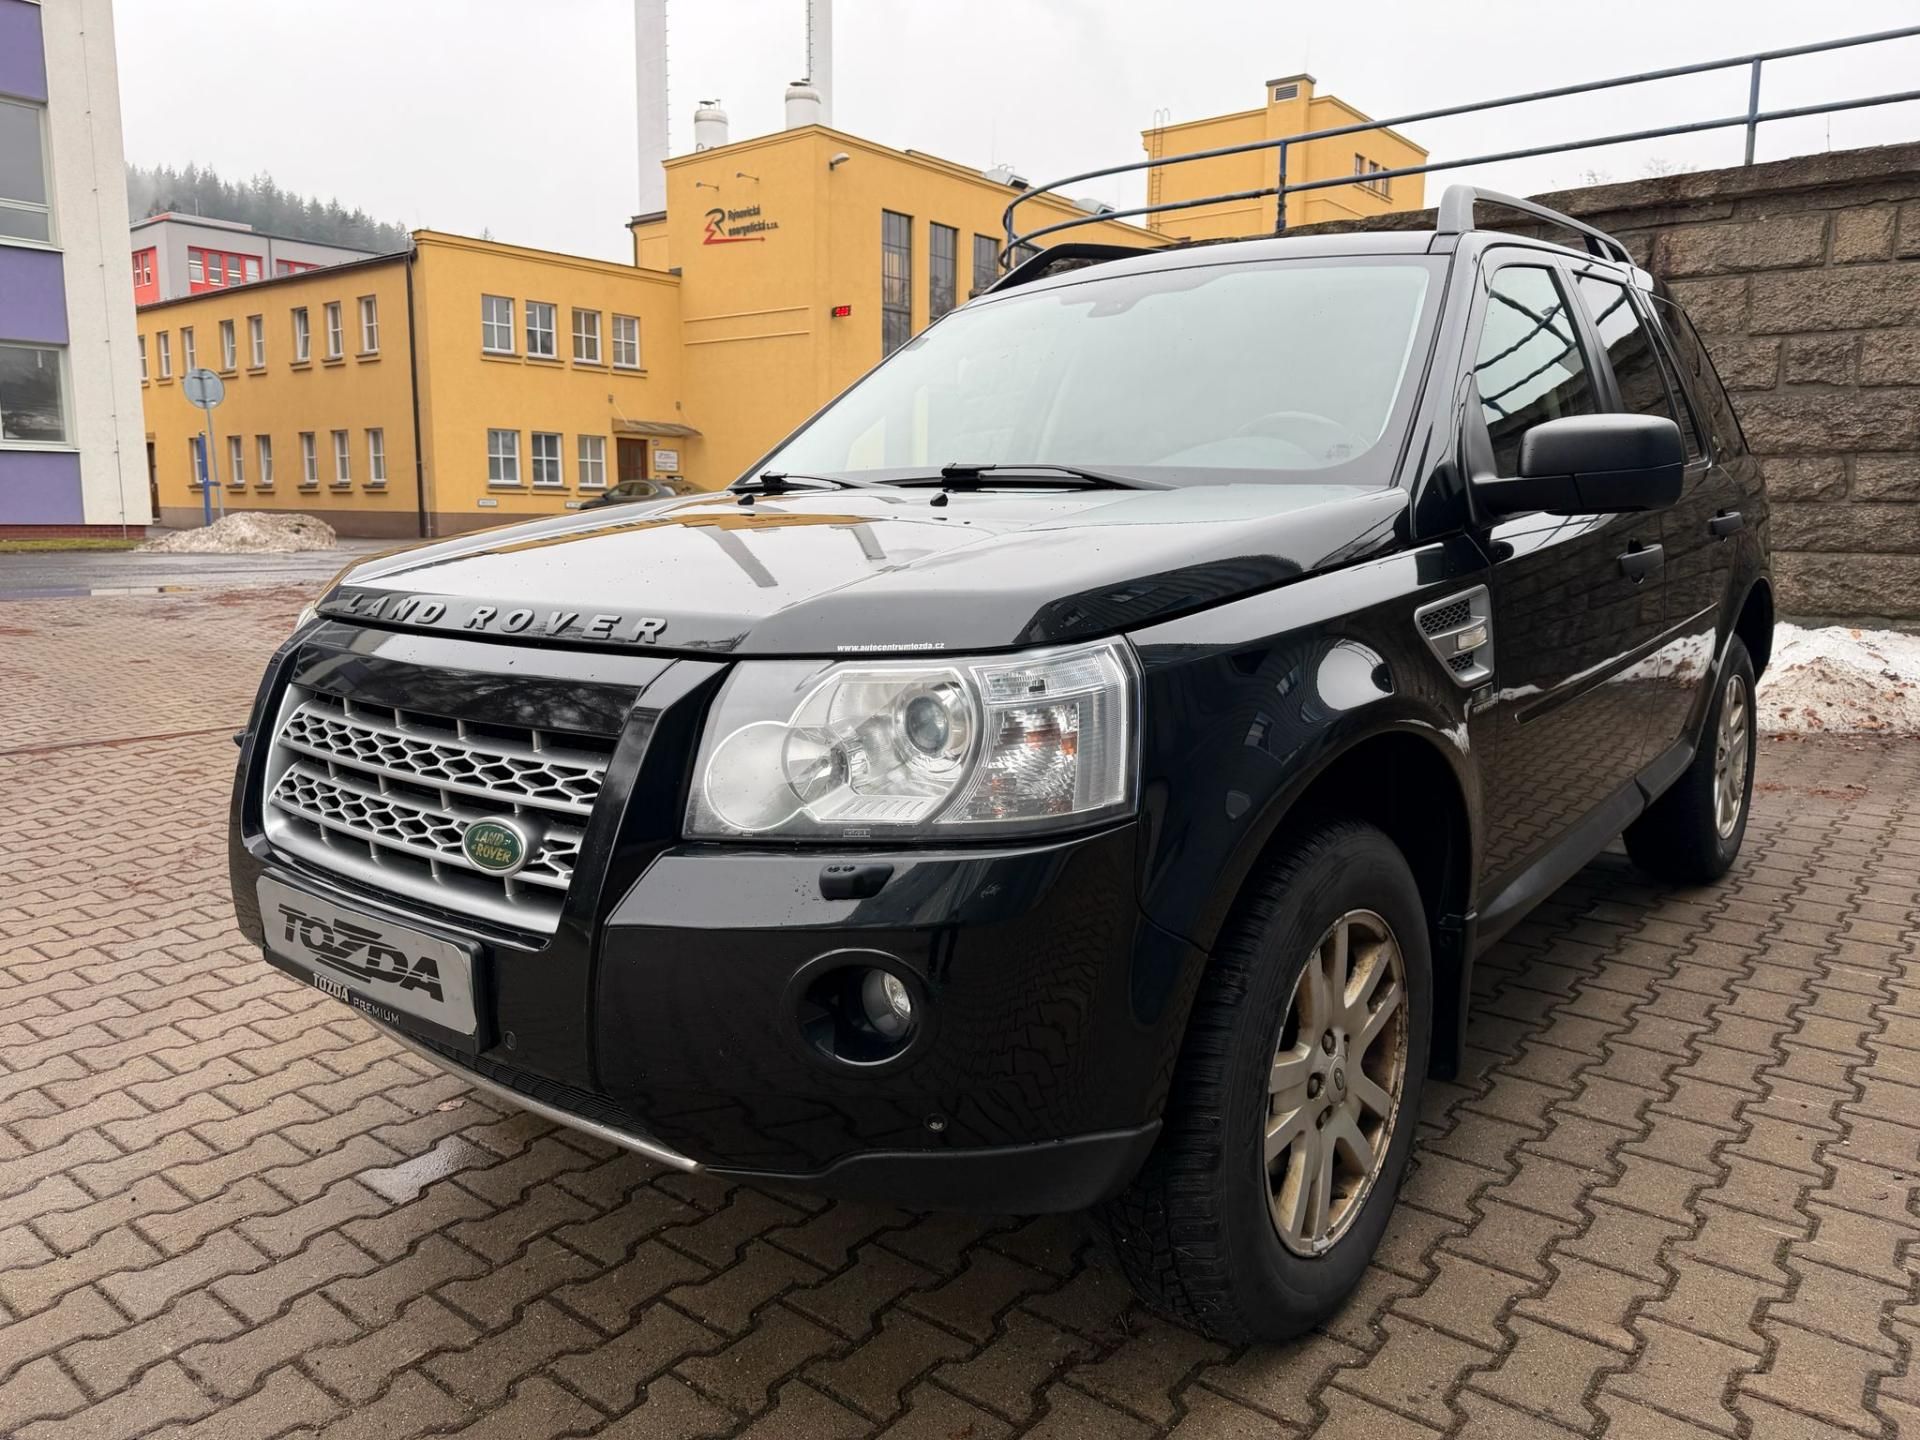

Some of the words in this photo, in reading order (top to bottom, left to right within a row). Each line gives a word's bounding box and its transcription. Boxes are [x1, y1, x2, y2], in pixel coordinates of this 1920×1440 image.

[345, 594, 446, 623] LAND
[463, 605, 667, 643] ROVER
[837, 642, 945, 651] www.autocentrumtozda.cz
[475, 829, 504, 846] LAND
[475, 843, 511, 862] ROVER
[278, 903, 444, 1003] TOZDA
[312, 972, 350, 1002] TOZDA
[352, 996, 400, 1025] PREMIUM
